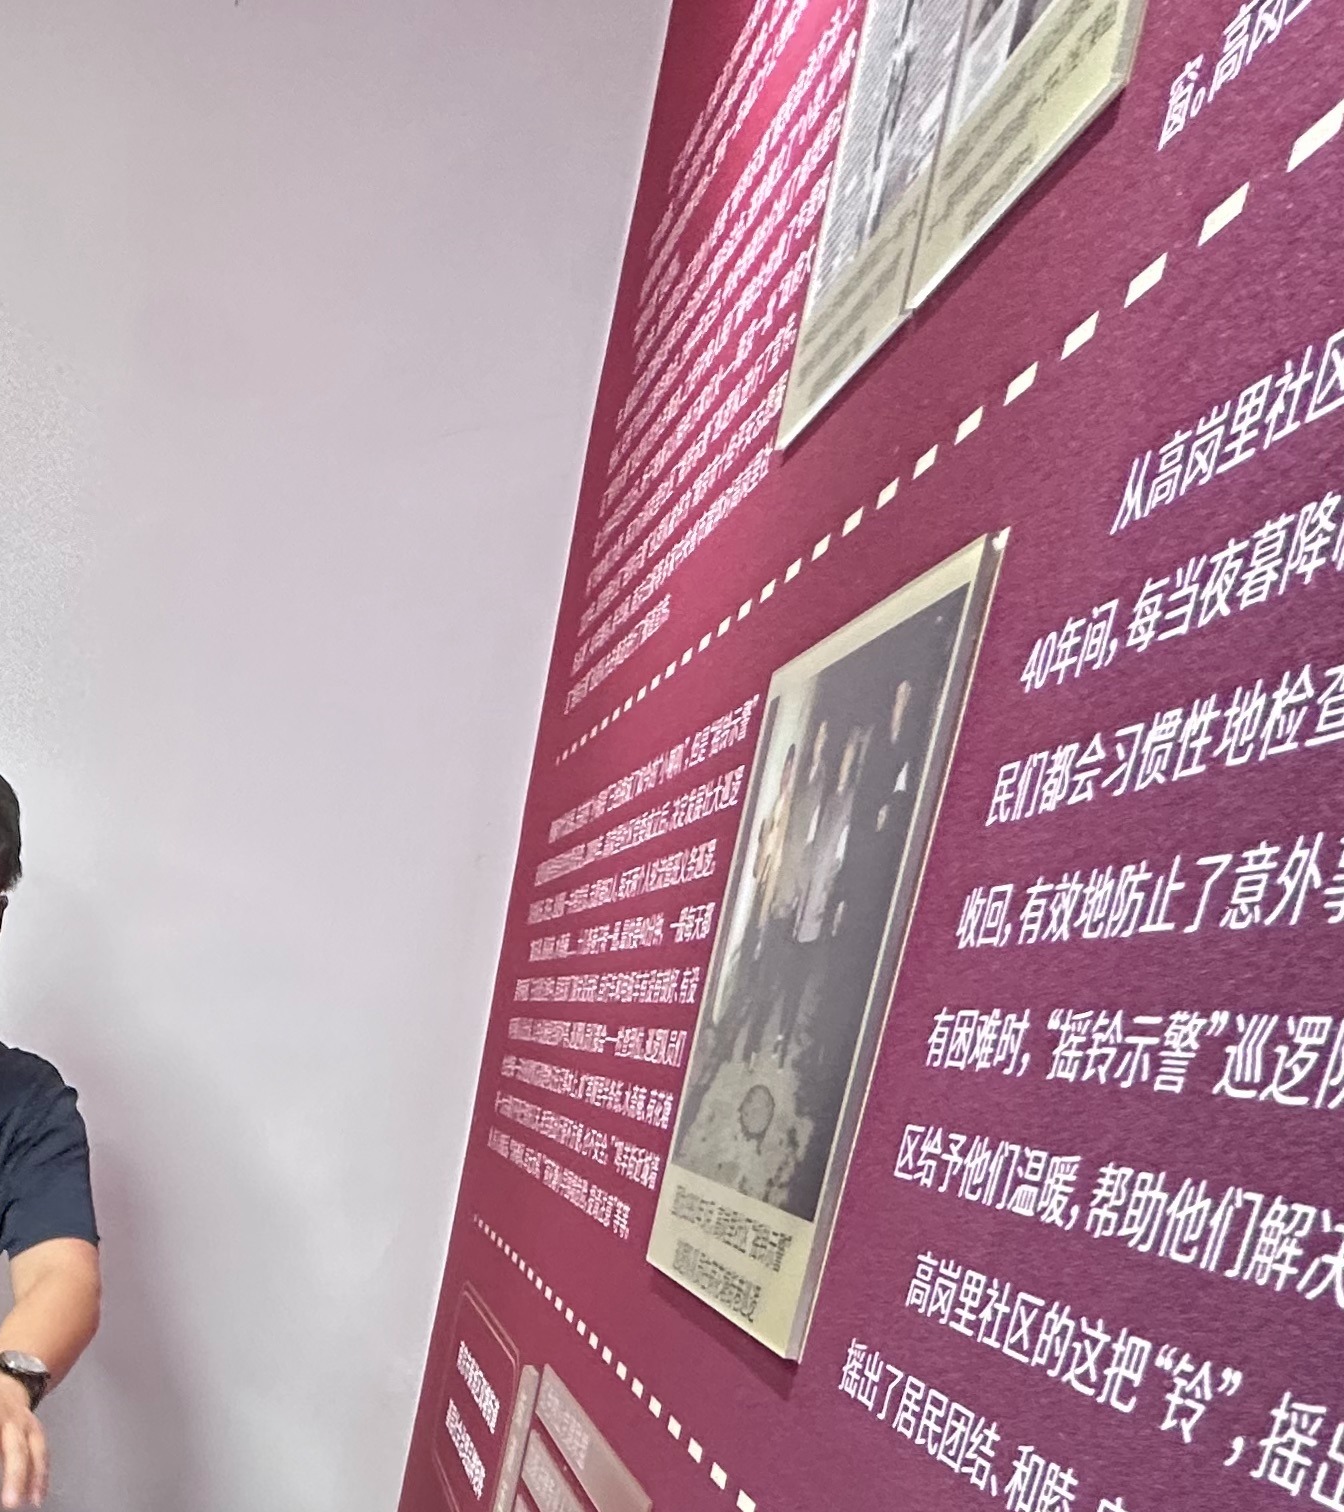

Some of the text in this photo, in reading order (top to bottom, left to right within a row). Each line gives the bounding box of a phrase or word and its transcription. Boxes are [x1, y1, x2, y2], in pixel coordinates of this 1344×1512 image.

[1020, 490, 1344, 693] 40年间，每当夜暮降
